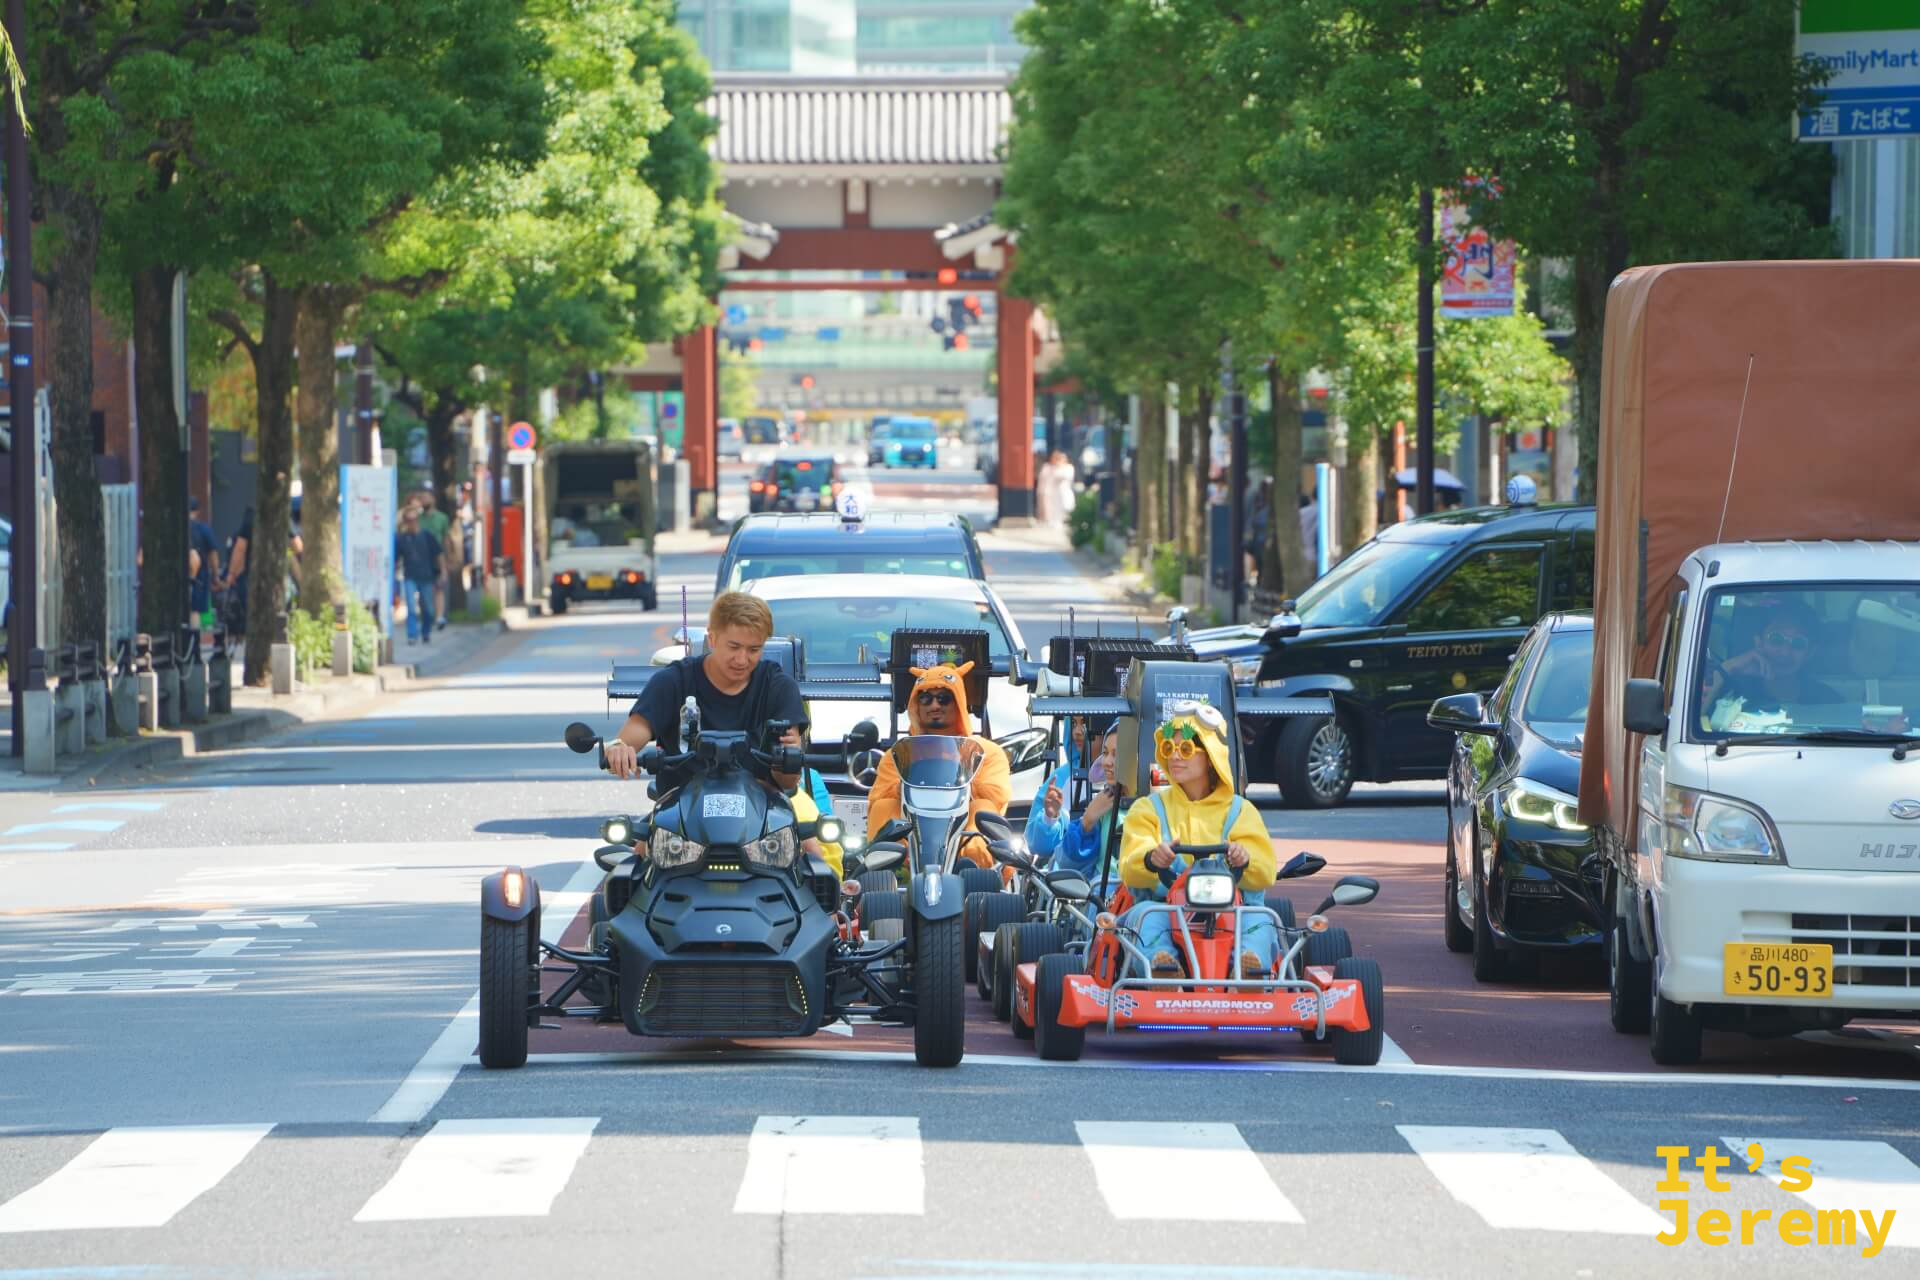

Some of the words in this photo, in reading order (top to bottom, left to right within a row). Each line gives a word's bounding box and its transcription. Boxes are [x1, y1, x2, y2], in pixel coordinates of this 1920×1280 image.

[1802, 48, 1919, 74] FamilyMart
[1809, 106, 1840, 135] 酒
[1850, 108, 1911, 131] たばこ
[1407, 646, 1449, 658] TEITO
[1451, 643, 1484, 656] TAXI
[1859, 843, 1920, 859] HIJ
[1747, 964, 1827, 993] 50-93
[1155, 999, 1275, 1010] STANDARDMOTO
